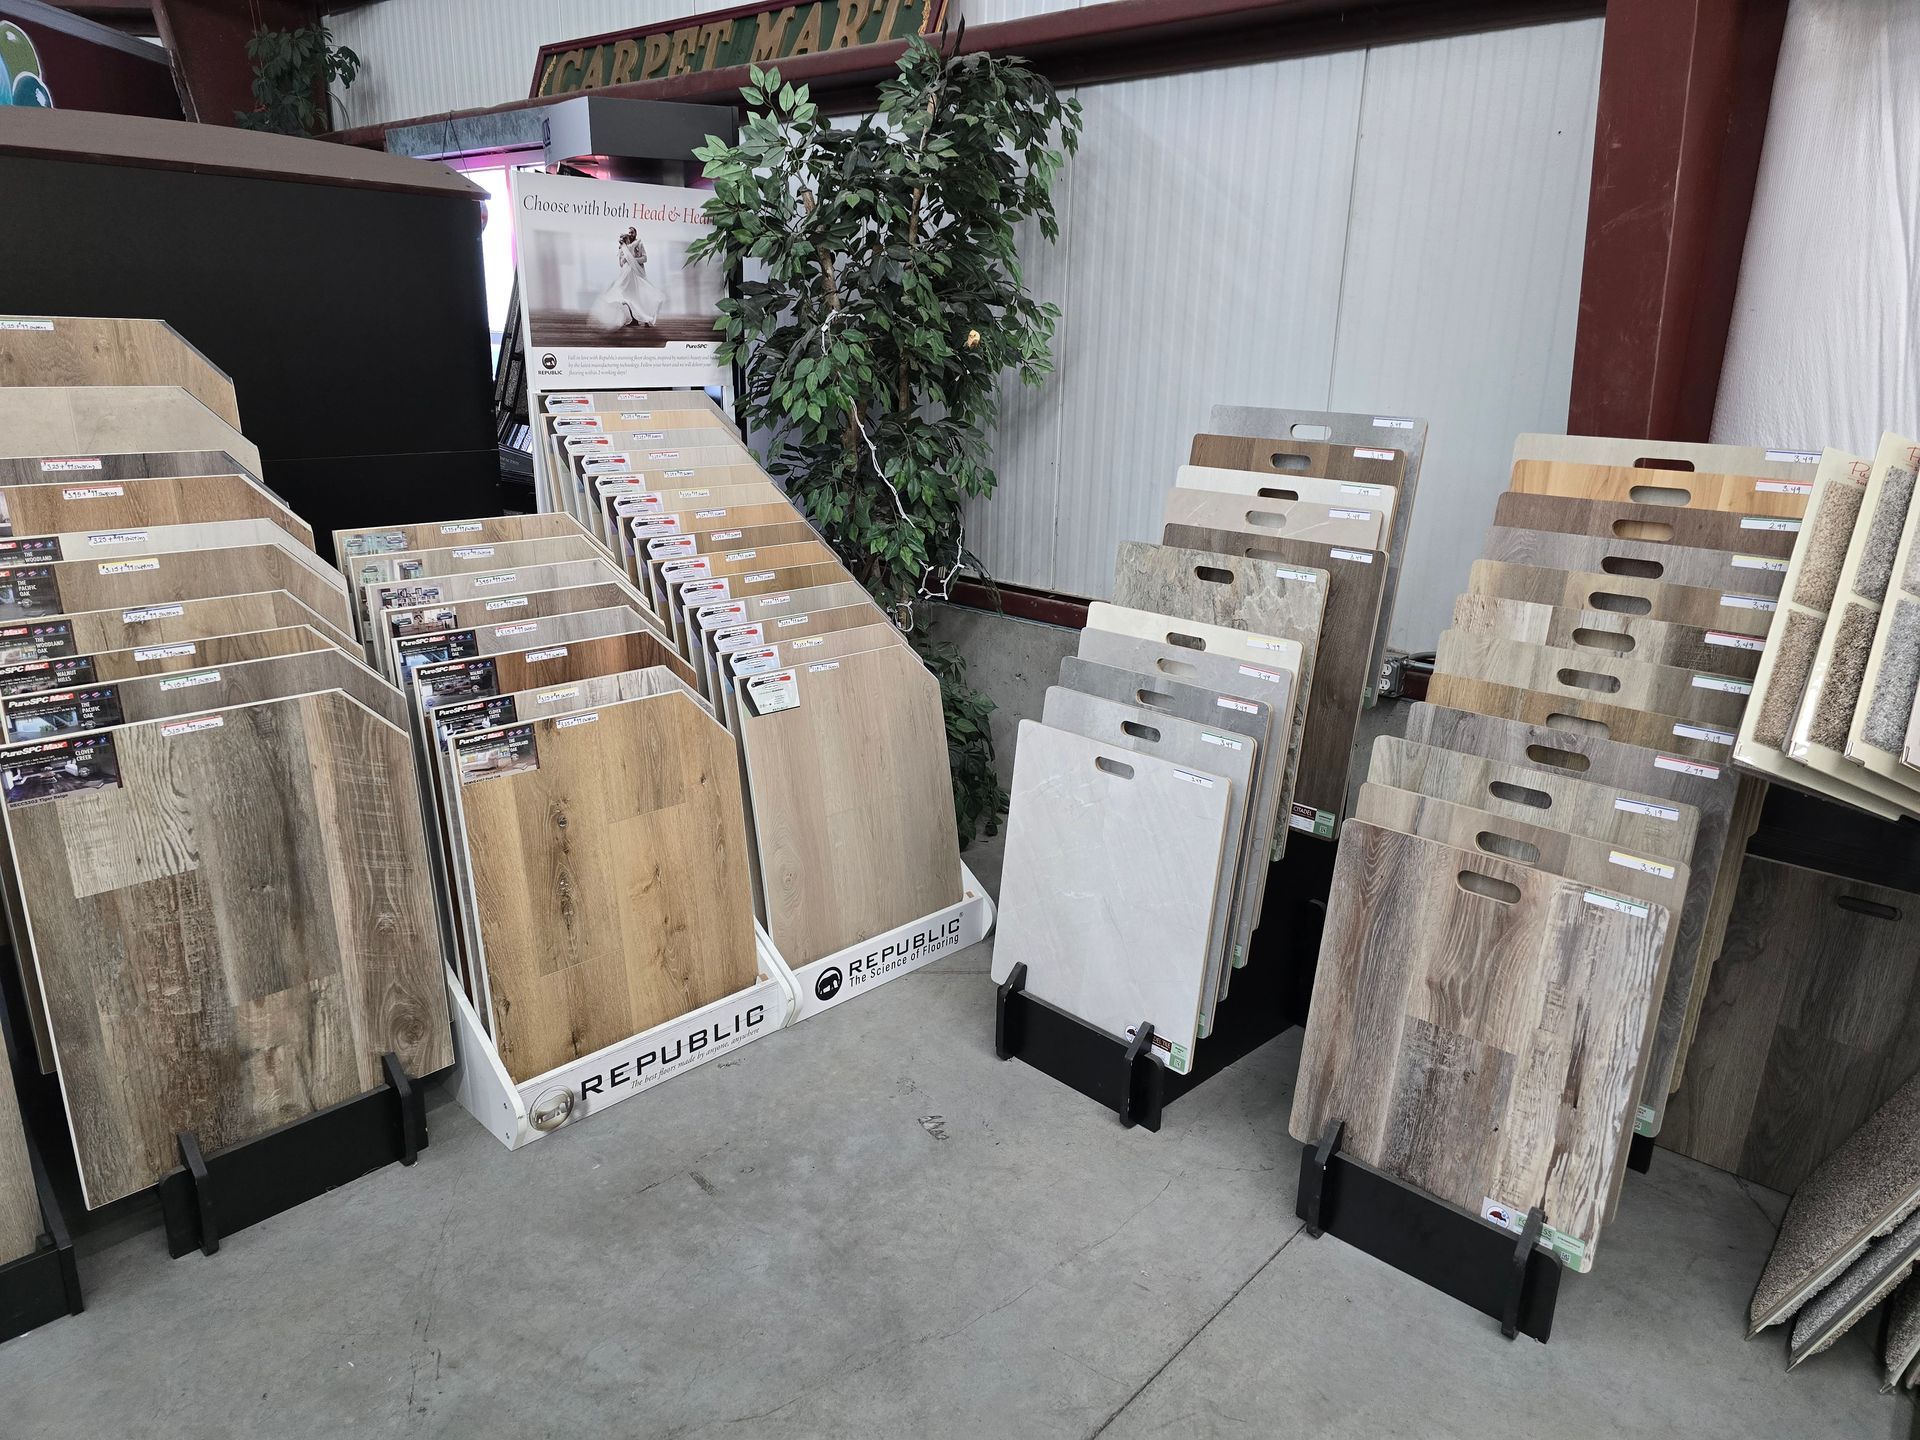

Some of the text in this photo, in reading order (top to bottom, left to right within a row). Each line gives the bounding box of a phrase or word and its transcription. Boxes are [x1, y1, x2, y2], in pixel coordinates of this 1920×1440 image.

[552, 0, 913, 94] CARPET MART
[524, 195, 570, 213] Choose
[573, 200, 600, 215] with
[604, 201, 628, 218] both
[632, 203, 666, 221] Head
[668, 206, 680, 222] &
[1794, 455, 1814, 464] 3.49
[1782, 486, 1801, 494] 3.49
[1762, 562, 1783, 570] 3.49
[1752, 602, 1770, 611] 3.49
[401, 638, 428, 646] PureSPC
[1734, 640, 1754, 649] 3.49
[420, 667, 448, 676] PureSPC
[1722, 683, 1742, 693] 3.49
[8, 694, 70, 708] PureSPC Max
[440, 706, 466, 716] PureSPC
[459, 735, 486, 746] PureSPC
[1704, 733, 1720, 743] 3.19
[1, 742, 64, 758] PureSPC Max
[1293, 806, 1312, 816] CITADEL
[1644, 808, 1662, 817] 3.19
[1640, 864, 1662, 876] 3.49
[1615, 902, 1632, 914] 3.19
[849, 918, 960, 976] REPUBLIC
[849, 934, 960, 988] The Science of Flooring
[581, 1004, 764, 1101] REPUBLIC
[631, 1028, 760, 1088] The best floors made by anyone, anywhere
